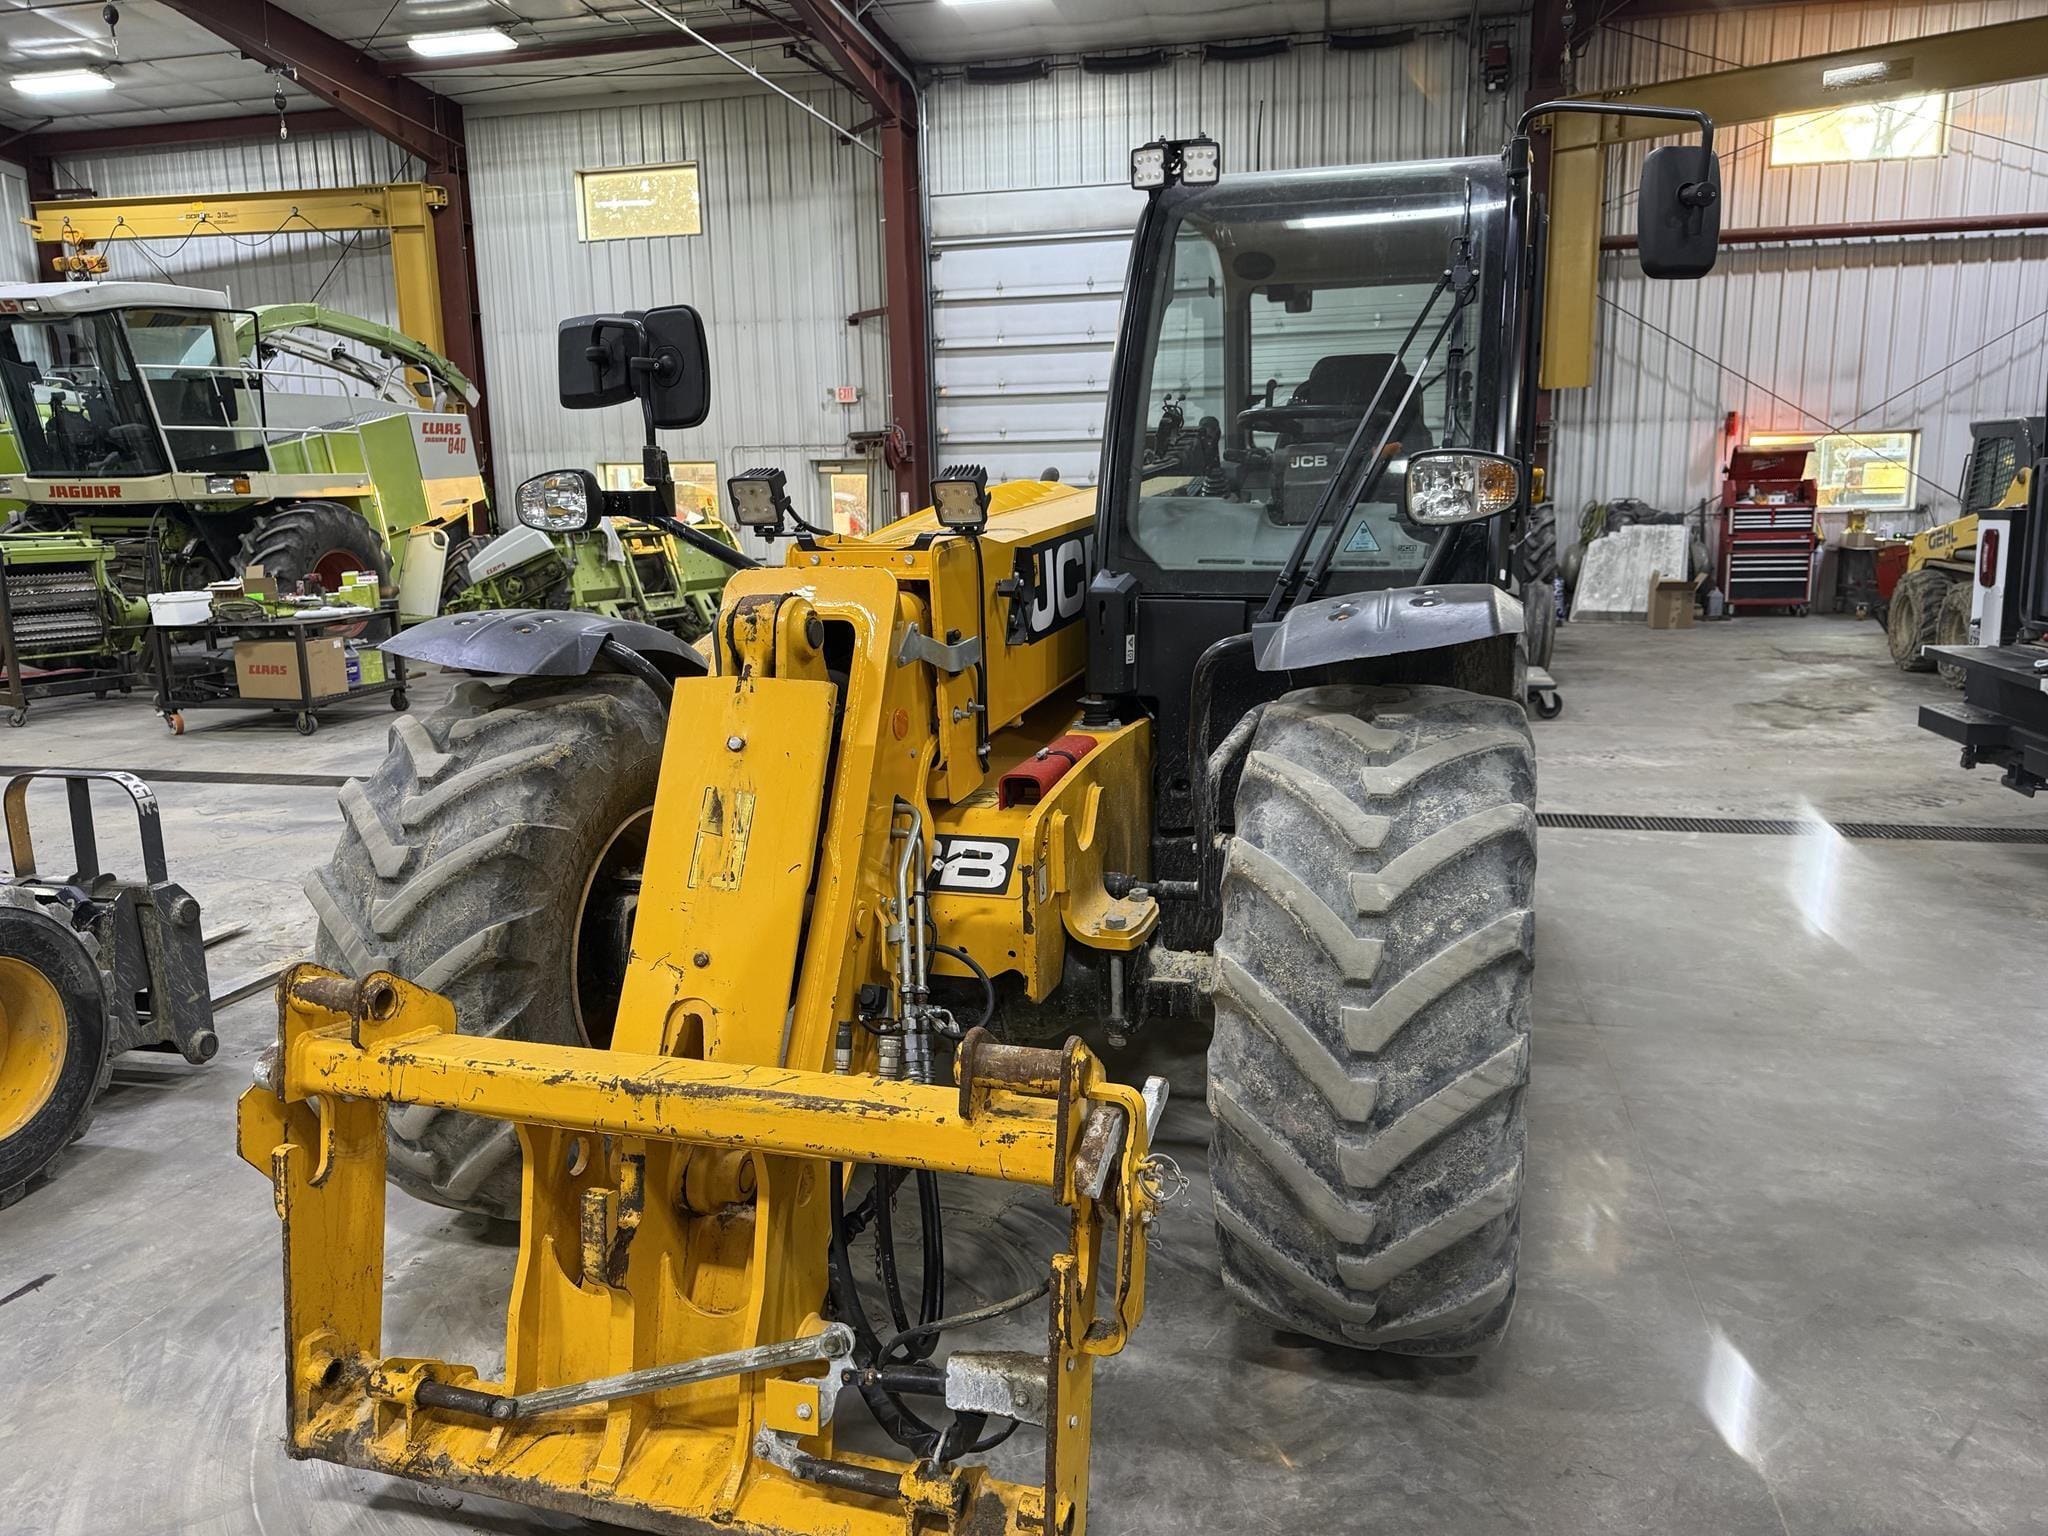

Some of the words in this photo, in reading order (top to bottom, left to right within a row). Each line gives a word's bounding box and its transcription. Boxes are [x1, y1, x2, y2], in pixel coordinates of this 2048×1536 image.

[838, 387, 854, 400] EXIT
[422, 422, 462, 434] CLAAS
[448, 437, 466, 454] 840
[1290, 455, 1328, 468] JCB
[48, 485, 122, 498] JAGUAR
[1928, 525, 1958, 549] GEHL
[248, 664, 288, 676] CLAAS
